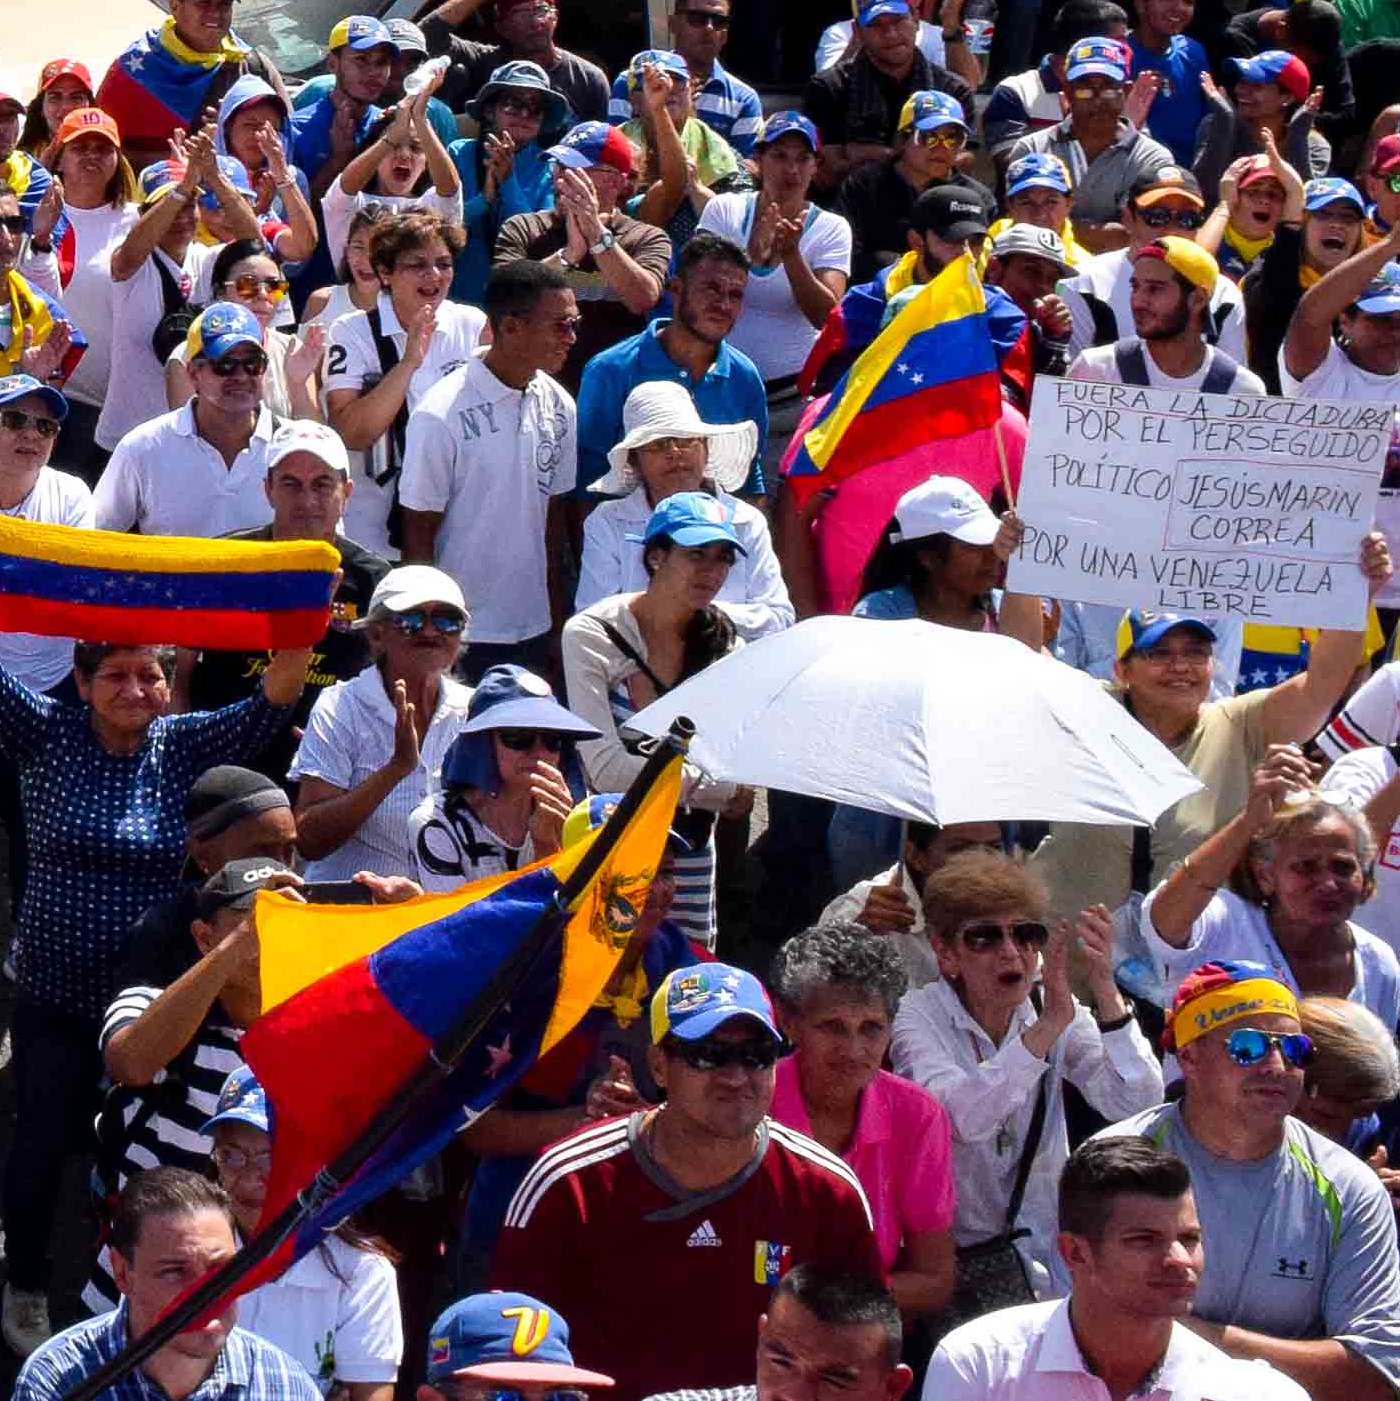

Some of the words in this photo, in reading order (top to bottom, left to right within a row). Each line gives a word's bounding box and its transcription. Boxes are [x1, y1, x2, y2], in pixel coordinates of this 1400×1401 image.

[327, 343, 349, 376] 2
[465, 401, 509, 441] NY
[1056, 381, 1150, 411] FUERA
[1168, 396, 1210, 421] LA
[1229, 397, 1393, 431] DICTADURA
[1064, 405, 1126, 442] POR
[1139, 416, 1173, 445] EL
[1182, 418, 1382, 464] PERSEGUIDO
[1189, 513, 1315, 548] CORREA
[1018, 526, 1070, 569] POR
[1080, 541, 1138, 581] UNA
[1150, 554, 1333, 595] VENEZUELA
[1157, 590, 1273, 618] LIBRE
[686, 1237, 723, 1248] adidas
